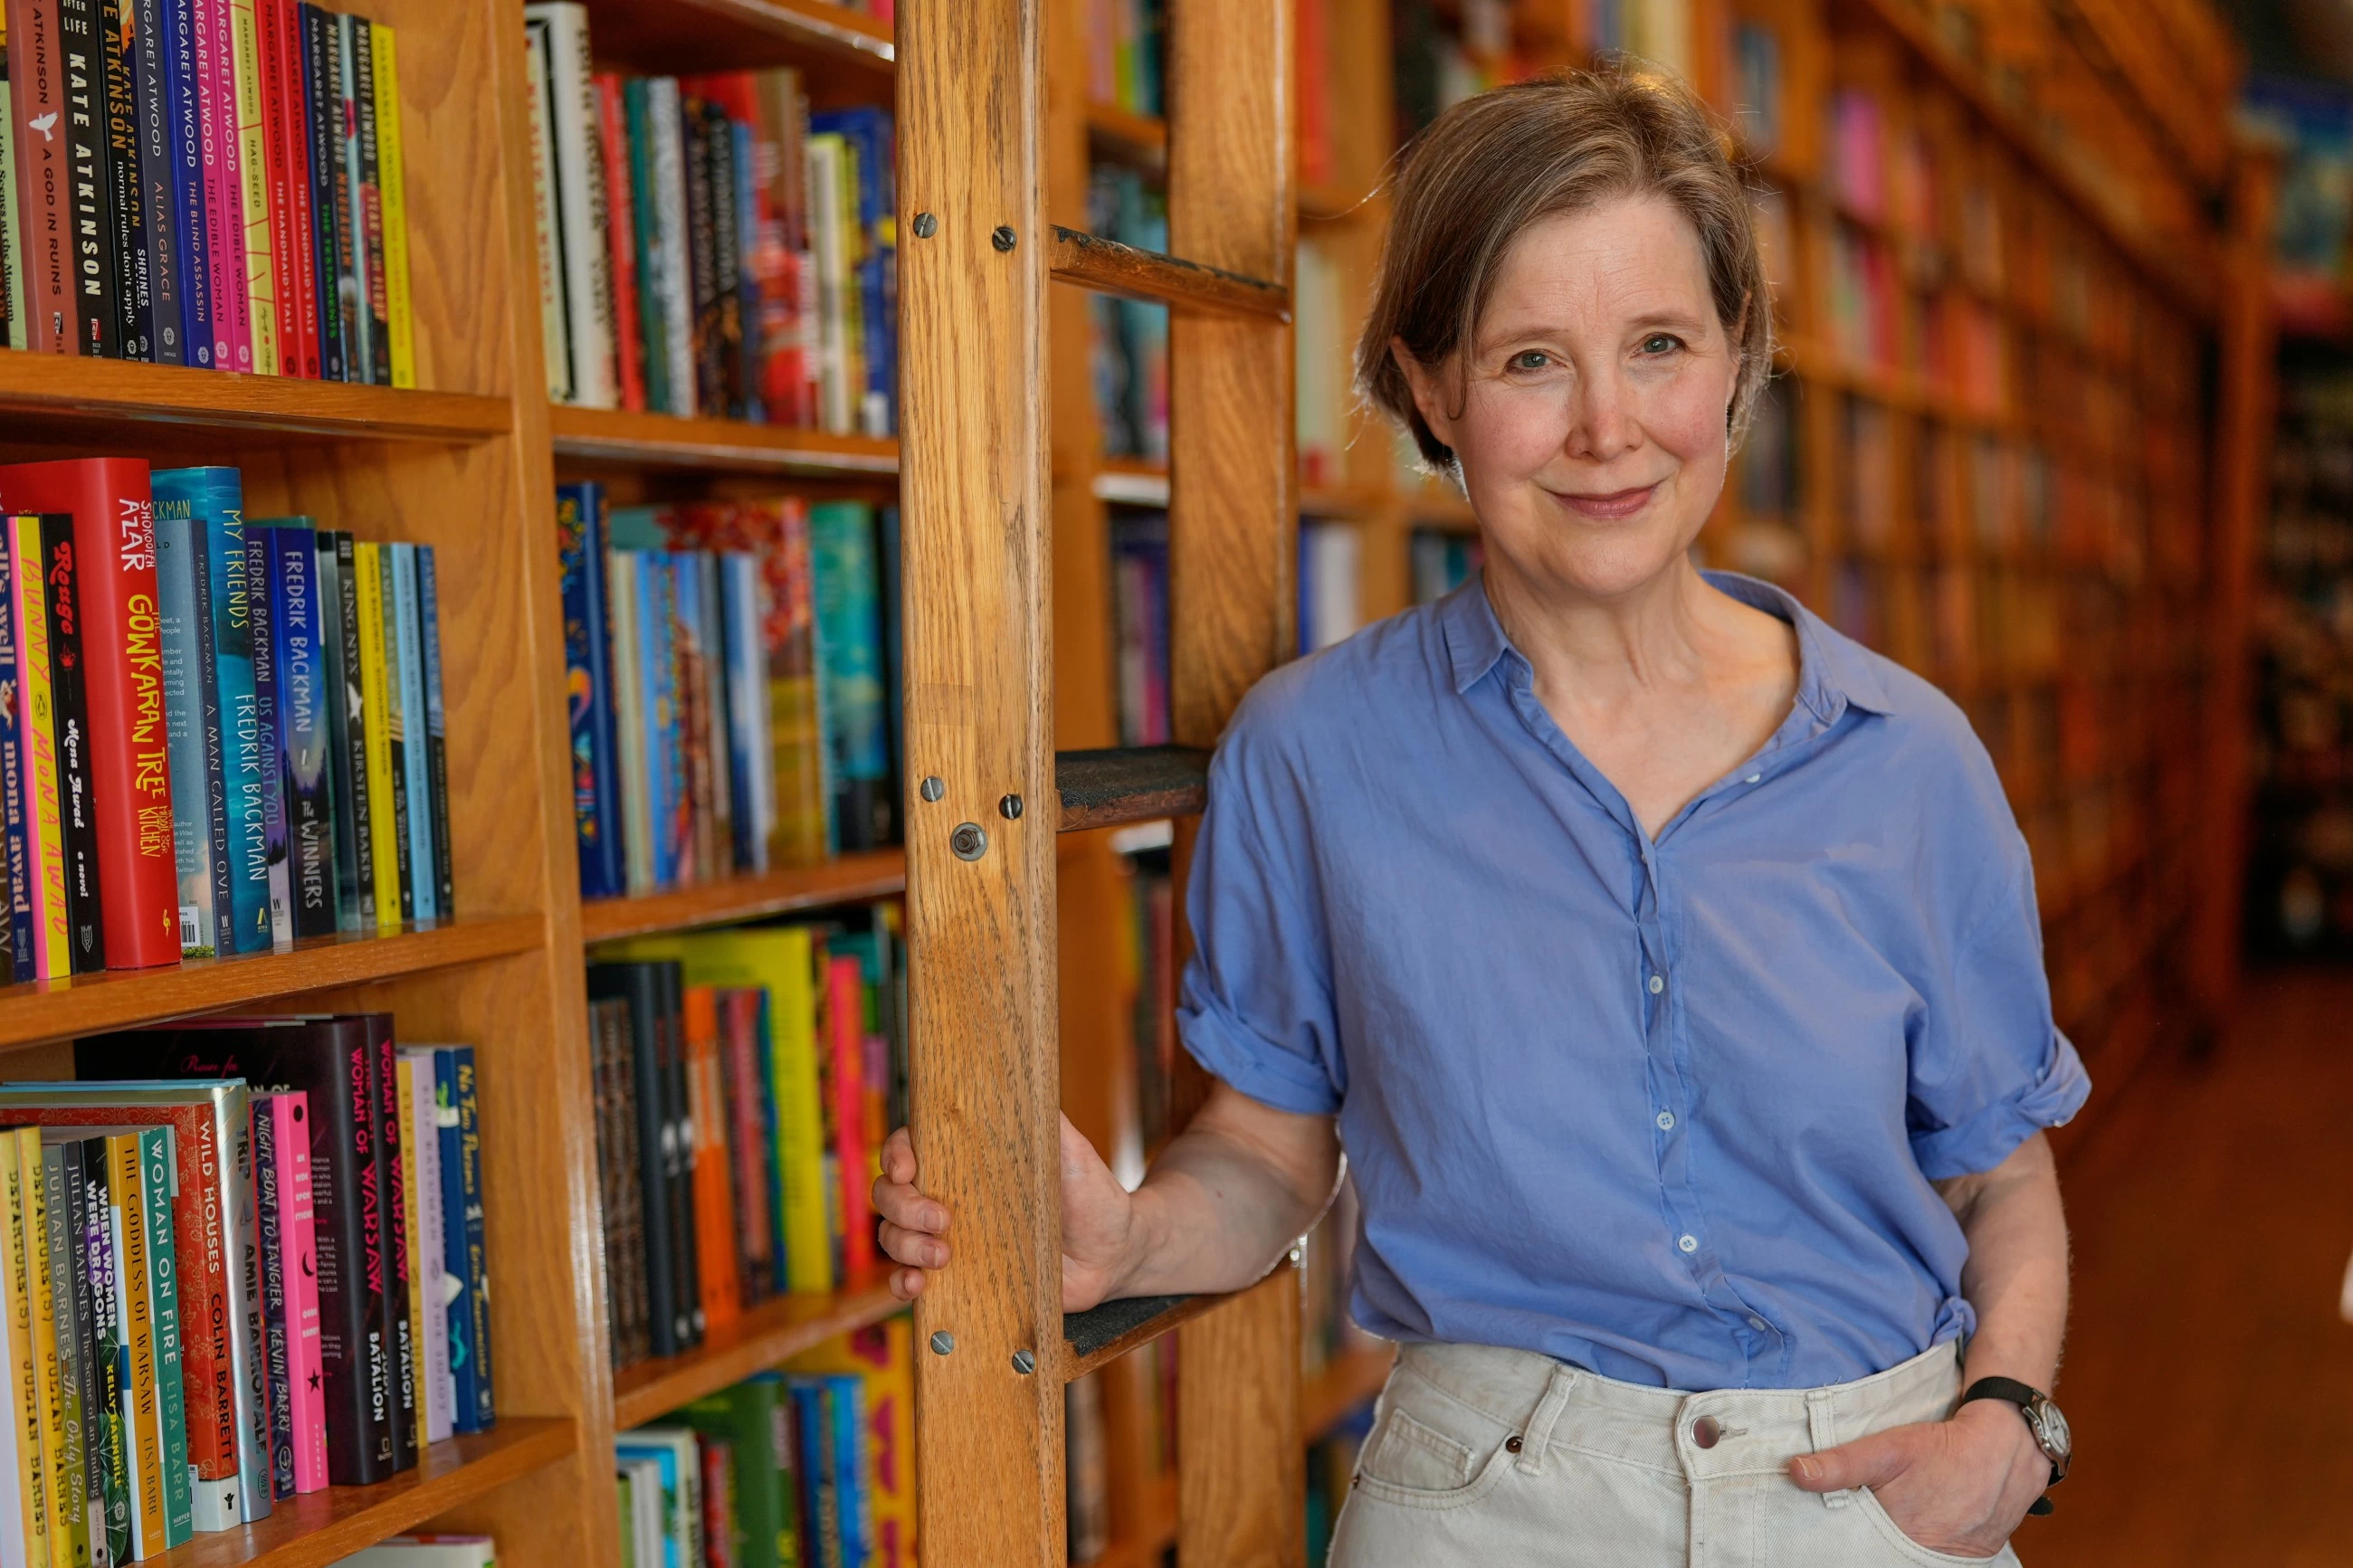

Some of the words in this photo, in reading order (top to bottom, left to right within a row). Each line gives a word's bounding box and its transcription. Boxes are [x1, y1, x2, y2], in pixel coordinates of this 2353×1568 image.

[63, 16, 88, 35] LIFE
[265, 5, 278, 91] MARGARET
[288, 8, 299, 95] MARGARET
[33, 7, 50, 105] ATKINSON
[310, 17, 324, 109] MARGARET
[69, 52, 90, 128] KATE
[104, 29, 127, 149] ATKINSON
[148, 74, 162, 157] ATWOOD
[242, 18, 252, 70] MARGARET
[249, 139, 261, 208] HAG-SEED
[43, 147, 52, 161] A
[182, 86, 196, 168] ATWOOD
[200, 85, 214, 166] ATWOOD
[222, 92, 236, 172] ATWOOD
[272, 98, 283, 169] ATWOOD
[292, 101, 304, 171] ATWOOD
[316, 111, 329, 187] ATWOOD
[43, 167, 56, 206] GOD
[117, 161, 129, 212] normal
[155, 181, 167, 233] ALIAS
[188, 181, 197, 206] THE
[207, 178, 217, 204] THE
[229, 184, 238, 209] THE
[276, 181, 285, 206] THE
[299, 184, 307, 209] THE
[47, 213, 57, 232] IN
[75, 143, 101, 296] ATKINSON
[120, 214, 129, 248] rules
[190, 211, 201, 252] BLIND
[209, 211, 220, 258] EDIBLE
[231, 214, 242, 263] EDIBLE
[321, 204, 331, 233] THE
[48, 238, 62, 296] RUINS
[123, 251, 132, 287] don't
[137, 248, 149, 308] SHRINES
[157, 238, 171, 302] GRACE
[278, 209, 291, 299] HANDMAID'S
[300, 212, 312, 300] HANDMAID'S
[123, 290, 135, 328] apply
[193, 255, 205, 323] ASSASSIN
[213, 262, 224, 323] WOMAN
[235, 268, 247, 328] WOMAN
[324, 238, 338, 339] TESTAMENTS
[283, 303, 292, 335] TALE
[305, 303, 315, 335] TALE
[119, 499, 145, 572] AZAR
[153, 499, 191, 520] CKMAN
[222, 509, 243, 541] MY
[49, 541, 73, 636] Rouge
[198, 554, 208, 611] FREDRIK
[224, 550, 250, 630] FRIENDS
[247, 540, 266, 602] FREDRIK
[284, 551, 308, 630] FREDRIK
[343, 578, 357, 629] KING
[126, 594, 163, 744] GOWKARAN
[203, 616, 213, 684] BACKMAN
[252, 608, 272, 683] BACKMAN
[347, 634, 359, 676] NYX
[205, 705, 215, 717] A
[258, 697, 273, 717] US
[289, 636, 313, 733] BACKMAN
[21, 557, 52, 686] BUNNY
[44, 841, 70, 936] AWAD
[64, 718, 80, 771] Mona
[207, 727, 221, 772] MAN
[235, 694, 260, 774] FREDRIK
[259, 722, 276, 786] AGAINST
[4, 740, 20, 826] mona
[68, 773, 85, 830] Awad
[135, 747, 167, 800] TREE
[353, 739, 367, 822] KIRSTEN
[137, 806, 162, 858] KITCHEN
[212, 780, 226, 852] CALLED
[242, 784, 268, 881] BACKMAN
[262, 791, 280, 826] YOU
[11, 834, 30, 915] awad
[77, 851, 84, 861] a
[78, 863, 90, 898] novel
[216, 860, 229, 900] OVE
[300, 819, 324, 909] WINNERS
[358, 825, 371, 884] BAKIS
[350, 1047, 367, 1123] WOMAN
[380, 1039, 395, 1115] WOMAN
[458, 1064, 474, 1093] No
[257, 1114, 273, 1163] NIGHT
[356, 1129, 369, 1155] OF
[385, 1120, 397, 1145] OF
[460, 1096, 478, 1130] Two
[124, 1145, 137, 1186] THE
[199, 1120, 214, 1178] WILD
[236, 1125, 252, 1181] TRIP
[295, 1173, 309, 1183] RIDE
[462, 1133, 480, 1195] Persons
[48, 1164, 65, 1253] JULIAN
[67, 1164, 83, 1235] JULIAN
[86, 1180, 100, 1238] WERE
[97, 1185, 111, 1246] WHEN
[150, 1138, 168, 1247] WOMAN
[262, 1167, 278, 1211] BOAT
[9, 1172, 30, 1330] DEPARTURE(S)
[33, 1164, 54, 1322] DEPARTURE(S)
[126, 1193, 145, 1293] GODDESS
[204, 1186, 221, 1275] HOUSES
[262, 1212, 277, 1238] TO
[362, 1160, 383, 1296] WARSAW
[75, 1244, 90, 1323] BARNES
[90, 1240, 108, 1341] DRAGONS
[100, 1248, 118, 1328] WOMEN
[157, 1257, 173, 1298] ON
[243, 1243, 259, 1302] AMIE
[266, 1242, 283, 1311] TANGIER
[55, 1262, 71, 1362] BARNES
[133, 1299, 148, 1325] OF
[161, 1309, 176, 1365] FIRE
[211, 1293, 226, 1361] COLIN
[82, 1328, 90, 1357] The
[269, 1328, 286, 1376] KEVIN
[398, 1320, 414, 1410] BATALION
[23, 1360, 39, 1441] JULIAN
[47, 1353, 62, 1433] JULIAN
[62, 1373, 78, 1410] The
[84, 1361, 93, 1402] Sense
[105, 1364, 117, 1409] KELLY
[137, 1333, 153, 1416] WARSAW
[368, 1332, 386, 1422] BATALION
[86, 1405, 94, 1419] of
[88, 1422, 95, 1443] an
[166, 1381, 178, 1432] LISA
[215, 1370, 233, 1461] BARRETT
[274, 1383, 291, 1434] BARRY
[64, 1419, 81, 1466] Only
[108, 1413, 124, 1489] BARNHILL
[143, 1436, 154, 1471] LISA
[170, 1441, 185, 1503] BARR
[30, 1456, 46, 1537] BARNES
[54, 1448, 70, 1527] BARNES
[66, 1472, 83, 1525] Story
[89, 1448, 100, 1499] Ending
[146, 1475, 158, 1517] BARR
[173, 1512, 191, 1525] HARPER
